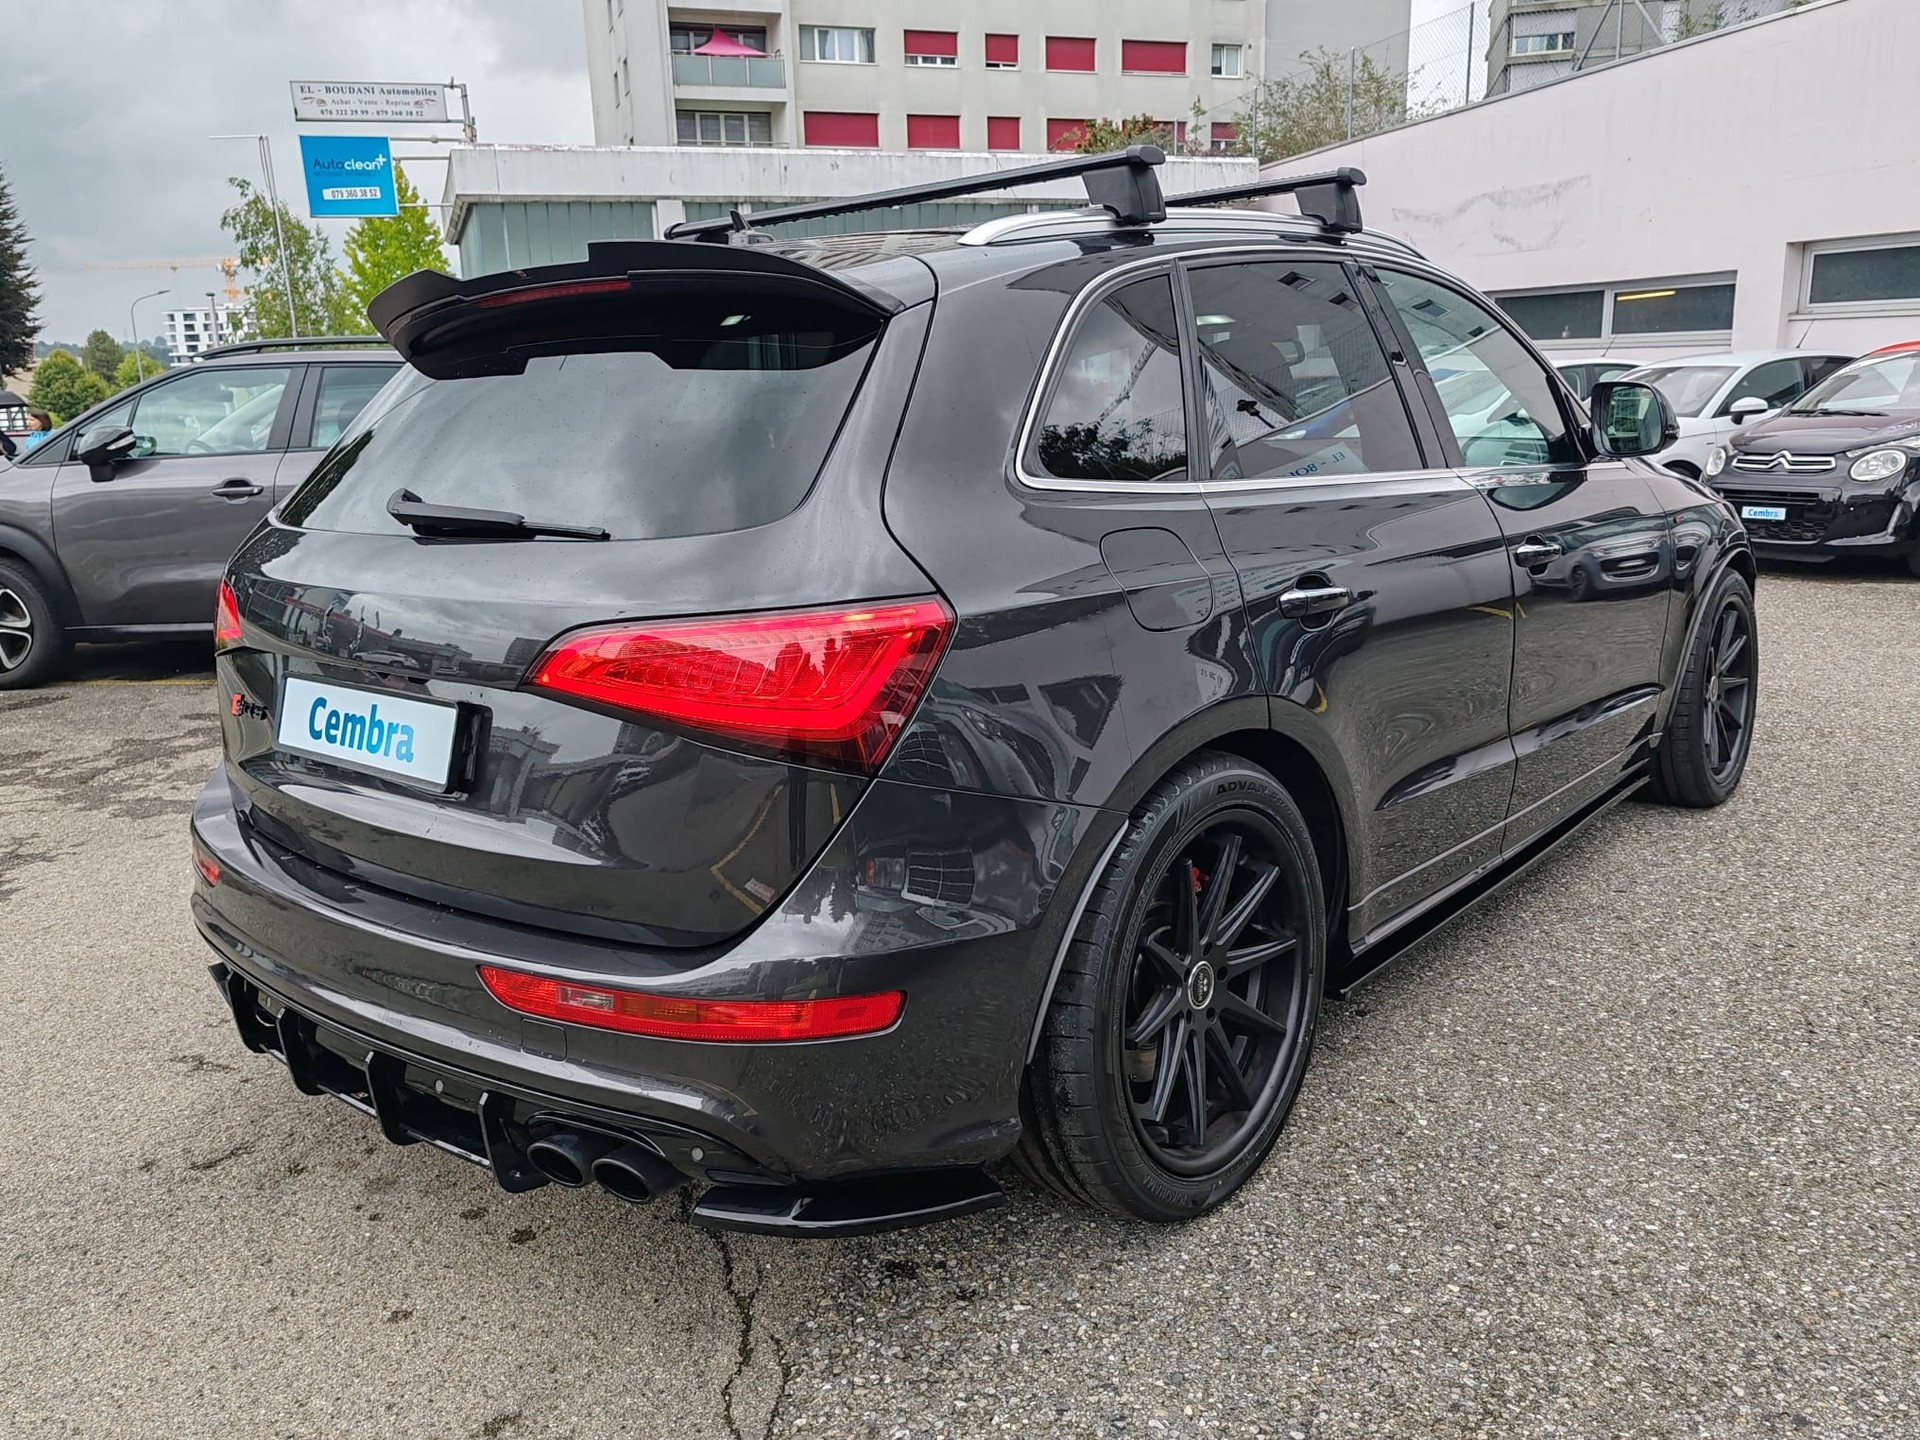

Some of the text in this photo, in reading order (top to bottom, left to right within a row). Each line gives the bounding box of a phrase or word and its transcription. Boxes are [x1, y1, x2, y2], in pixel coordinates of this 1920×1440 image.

[300, 85, 315, 94] EL
[325, 86, 375, 95] BOUDANI
[379, 87, 437, 96] Automobiles
[331, 98, 351, 106] Achat
[385, 99, 411, 107] Reprise
[331, 189, 378, 198] 079 360 38 52
[1748, 508, 1779, 518] Cembra
[308, 696, 415, 763] Cembra
